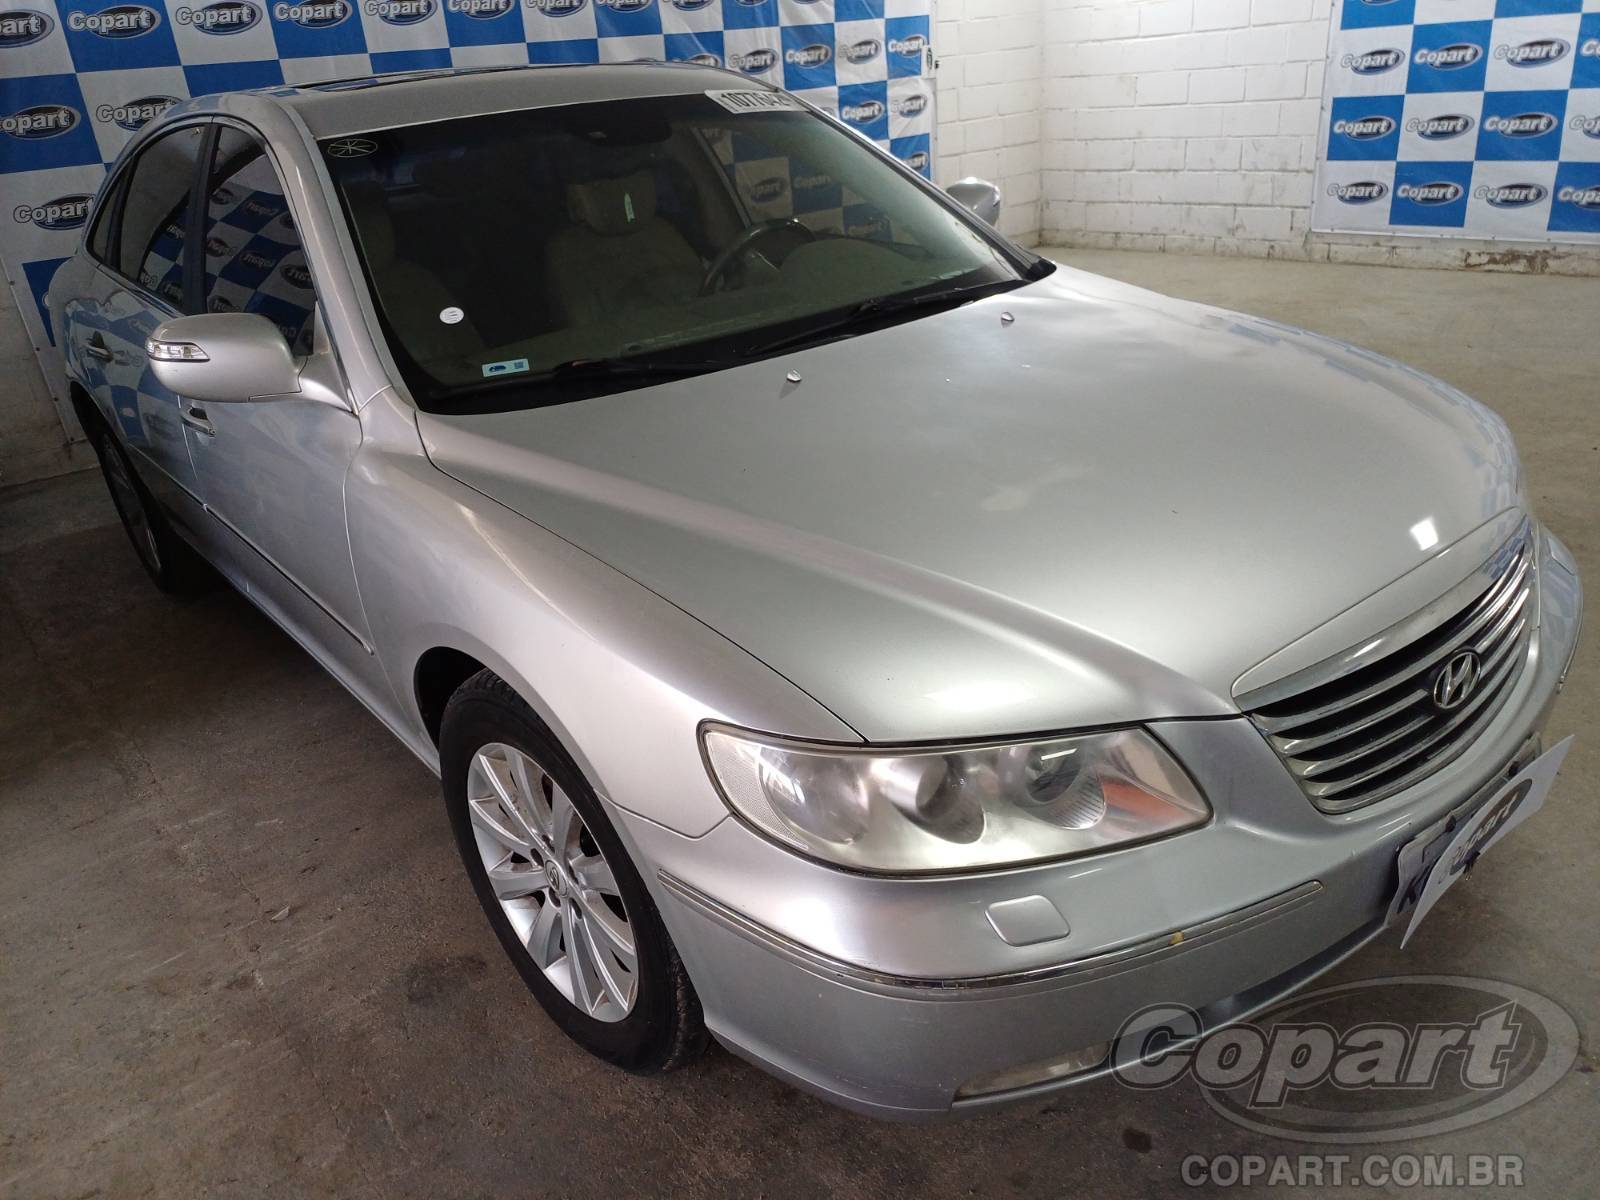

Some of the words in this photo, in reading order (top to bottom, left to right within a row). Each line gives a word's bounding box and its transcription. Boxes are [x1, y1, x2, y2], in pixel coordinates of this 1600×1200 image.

[176, 3, 252, 30] Copart
[274, 1, 343, 27] Copart
[364, 0, 427, 21] Copart
[447, 0, 507, 15] Copart
[0, 13, 41, 36] art
[67, 9, 150, 34] Copart
[727, 50, 773, 70] Copart
[785, 48, 827, 66] Copart
[1341, 50, 1397, 70] Copart
[1414, 45, 1475, 64] Copart
[1494, 40, 1560, 62] Copart
[0, 106, 71, 135] opart
[1333, 117, 1389, 136] Copart
[1406, 114, 1467, 135] Copart
[1484, 114, 1551, 136] Copart
[1327, 183, 1381, 200] Copart
[1397, 183, 1458, 202] Copart
[1474, 183, 1539, 203] Copart
